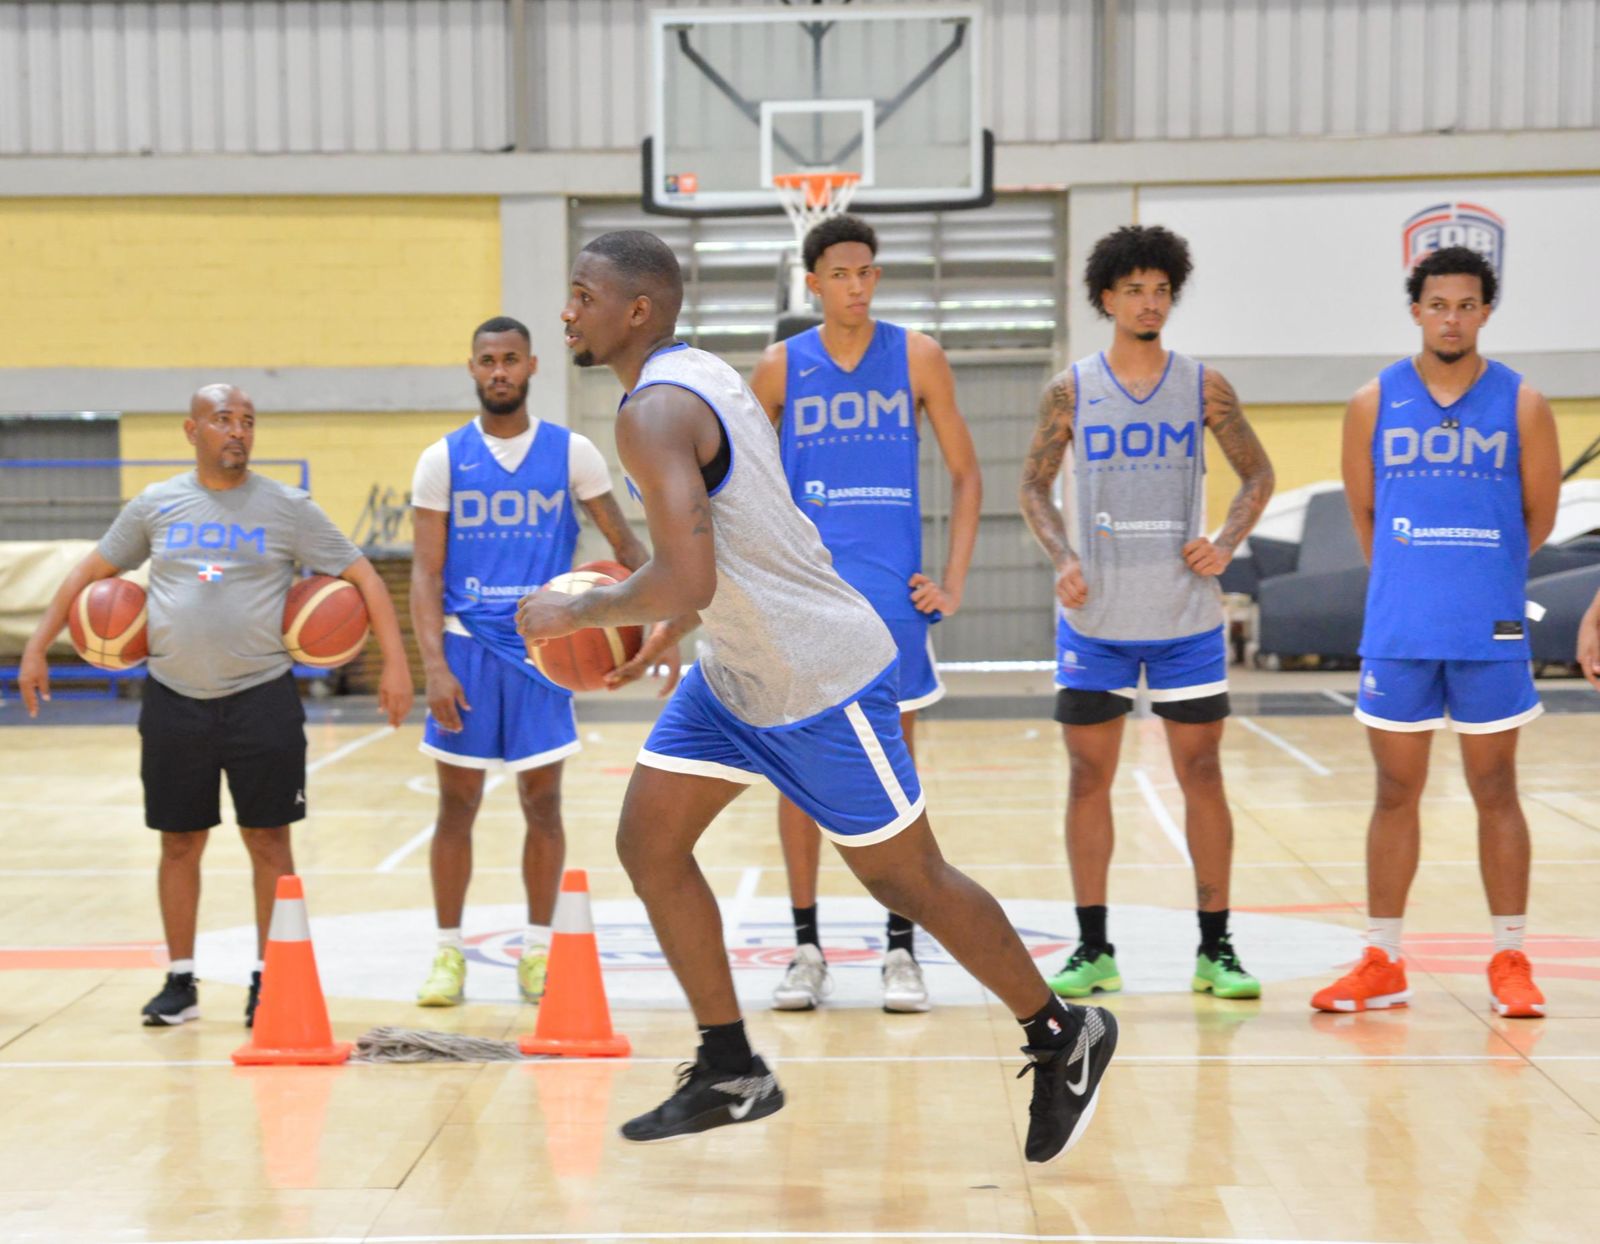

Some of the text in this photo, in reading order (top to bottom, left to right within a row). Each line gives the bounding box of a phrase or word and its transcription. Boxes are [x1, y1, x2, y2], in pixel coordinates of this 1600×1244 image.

[794, 389, 910, 436] DOM
[1083, 421, 1195, 461] DOM
[1383, 426, 1507, 468] DOM
[453, 489, 565, 528] DOM
[828, 487, 912, 499] BANRESERVAS
[165, 522, 266, 555] DOM
[1412, 528, 1501, 540] BANRESERVAS
